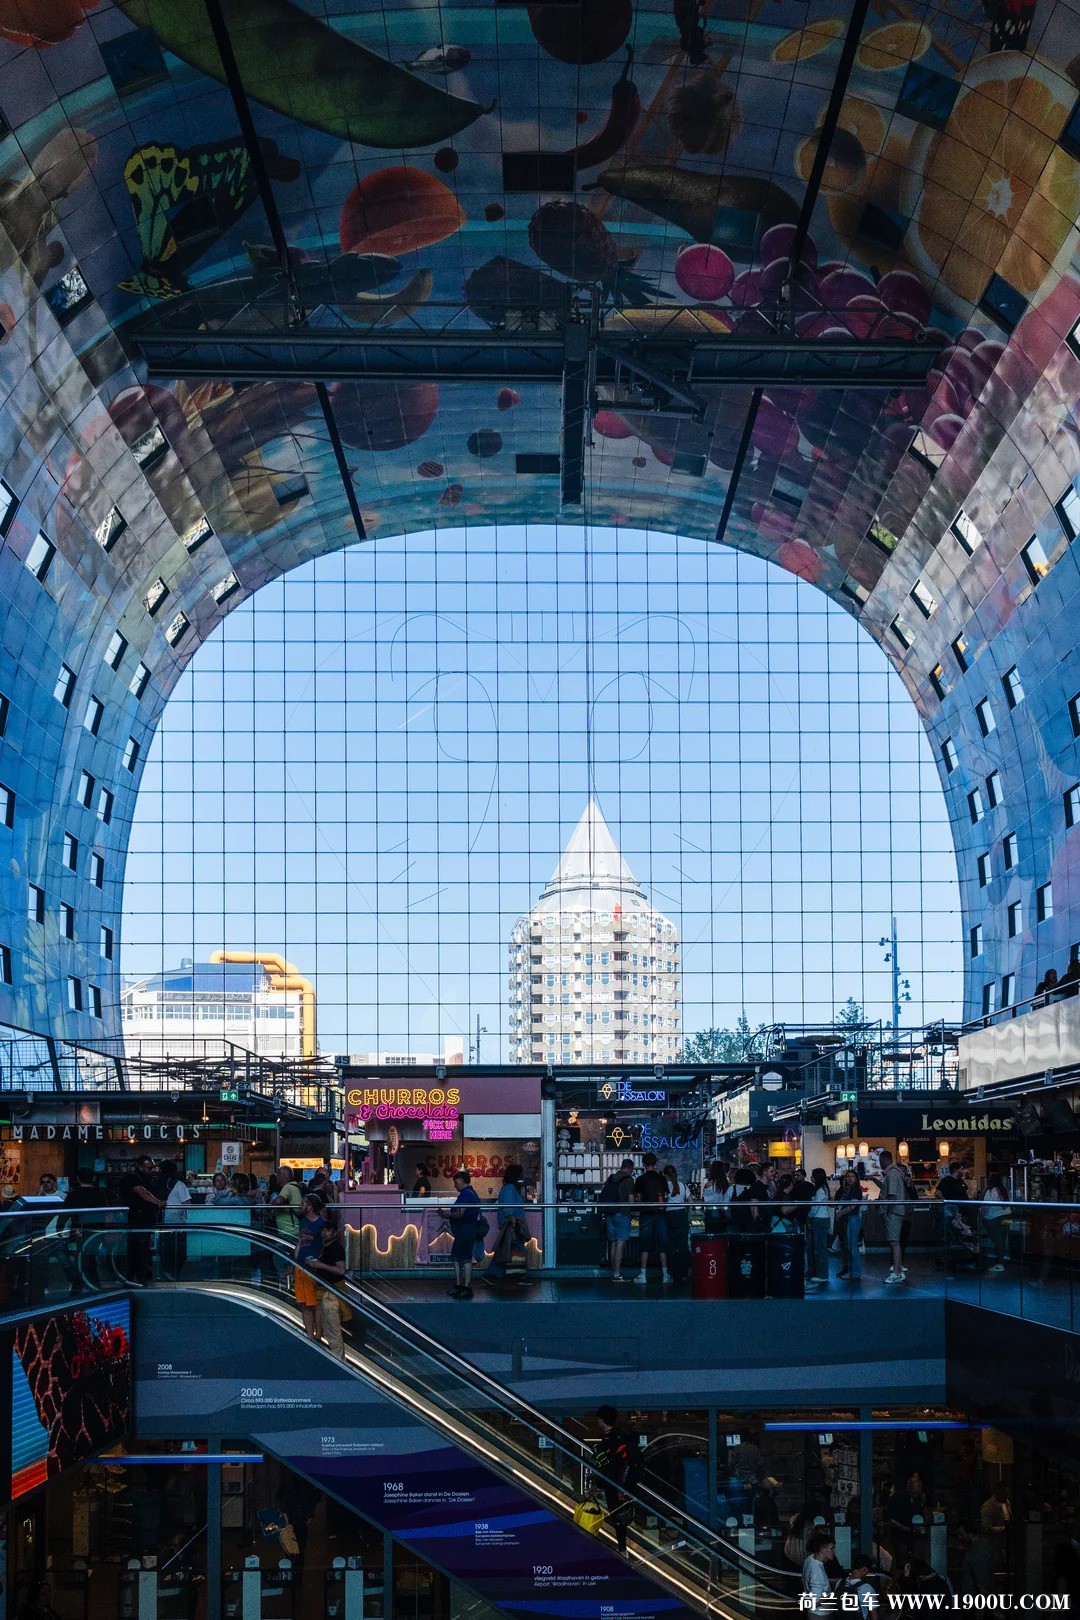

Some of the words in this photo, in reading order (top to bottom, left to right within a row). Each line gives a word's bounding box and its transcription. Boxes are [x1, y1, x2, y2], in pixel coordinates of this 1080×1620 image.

[347, 1088, 461, 1106] CHURROS
[360, 1104, 372, 1120] &
[375, 1102, 459, 1119] Chocolate
[423, 1120, 445, 1130] PICK
[446, 1120, 458, 1130] UP
[921, 1114, 1013, 1131] Leonidas
[13, 1125, 103, 1140] MADAME
[127, 1125, 201, 1140] COCOS
[428, 1130, 453, 1140] HERE
[425, 1154, 514, 1168] CHURROS
[157, 1363, 173, 1371] 2008
[241, 1387, 263, 1397] 2000
[383, 1482, 404, 1491] 1968
[532, 1565, 553, 1575] 1920
